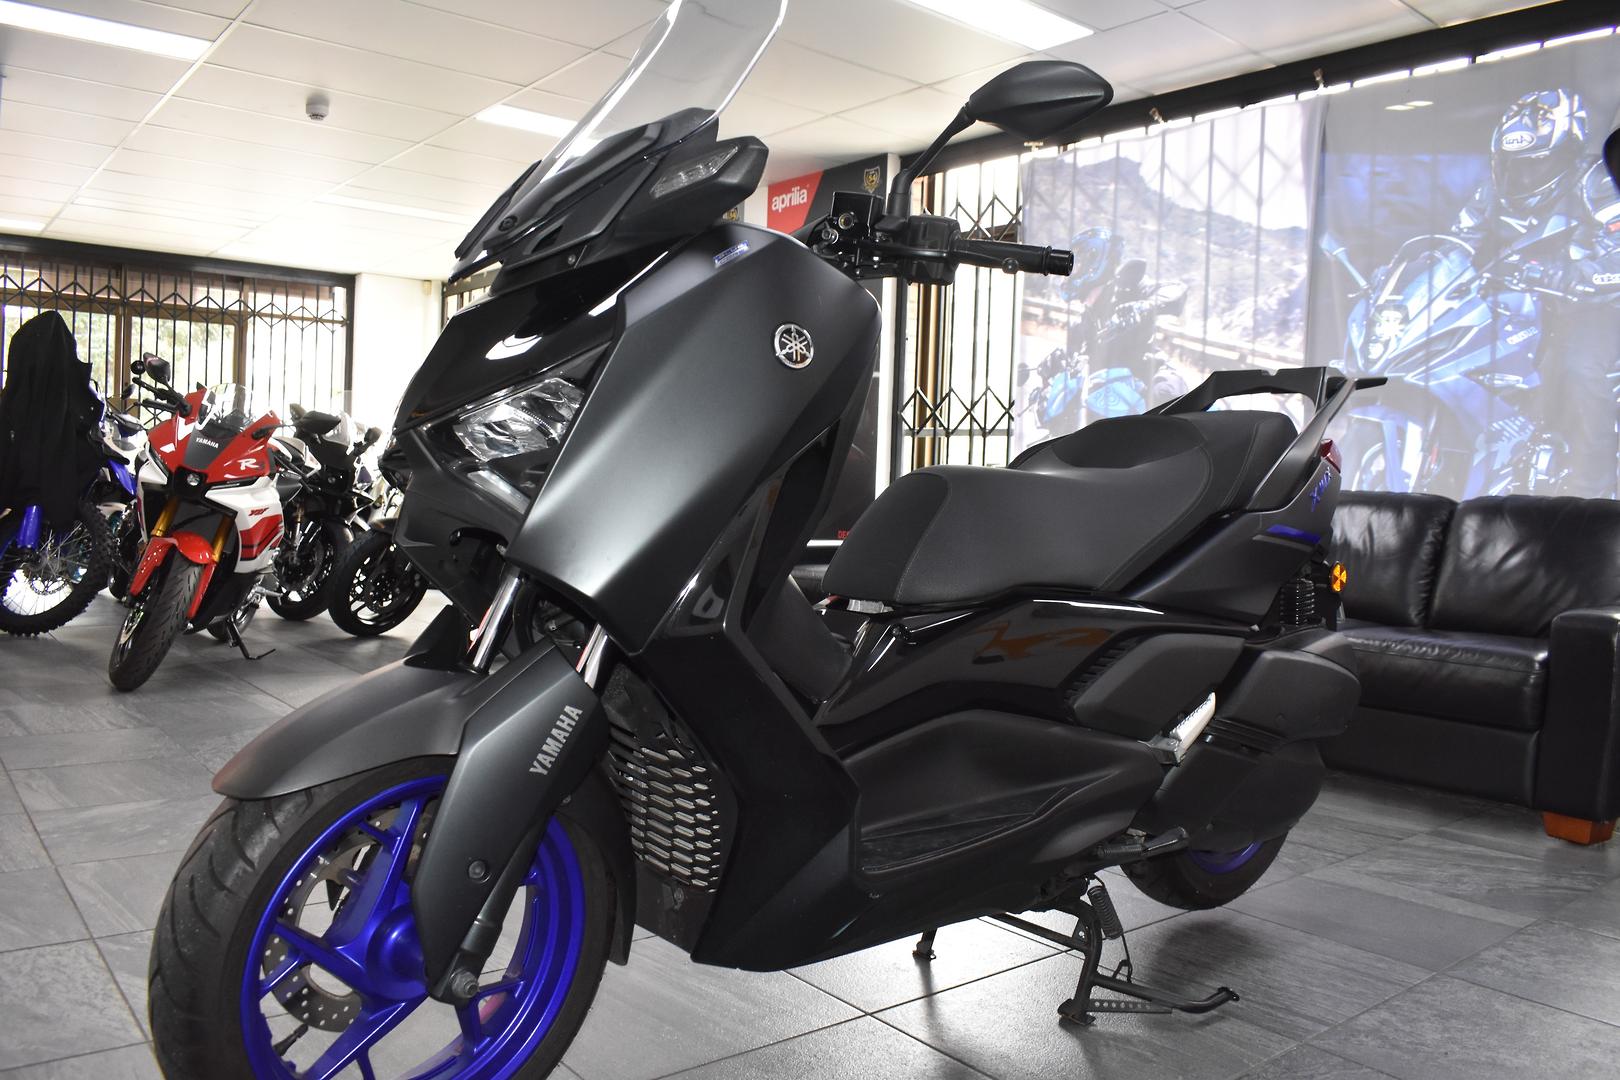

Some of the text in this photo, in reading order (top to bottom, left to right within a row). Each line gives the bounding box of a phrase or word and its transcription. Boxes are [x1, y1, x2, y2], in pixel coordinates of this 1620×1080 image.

[772, 186, 808, 212] aprilia
[196, 437, 219, 449] YAMAHA
[529, 705, 583, 775] YAMAHA
